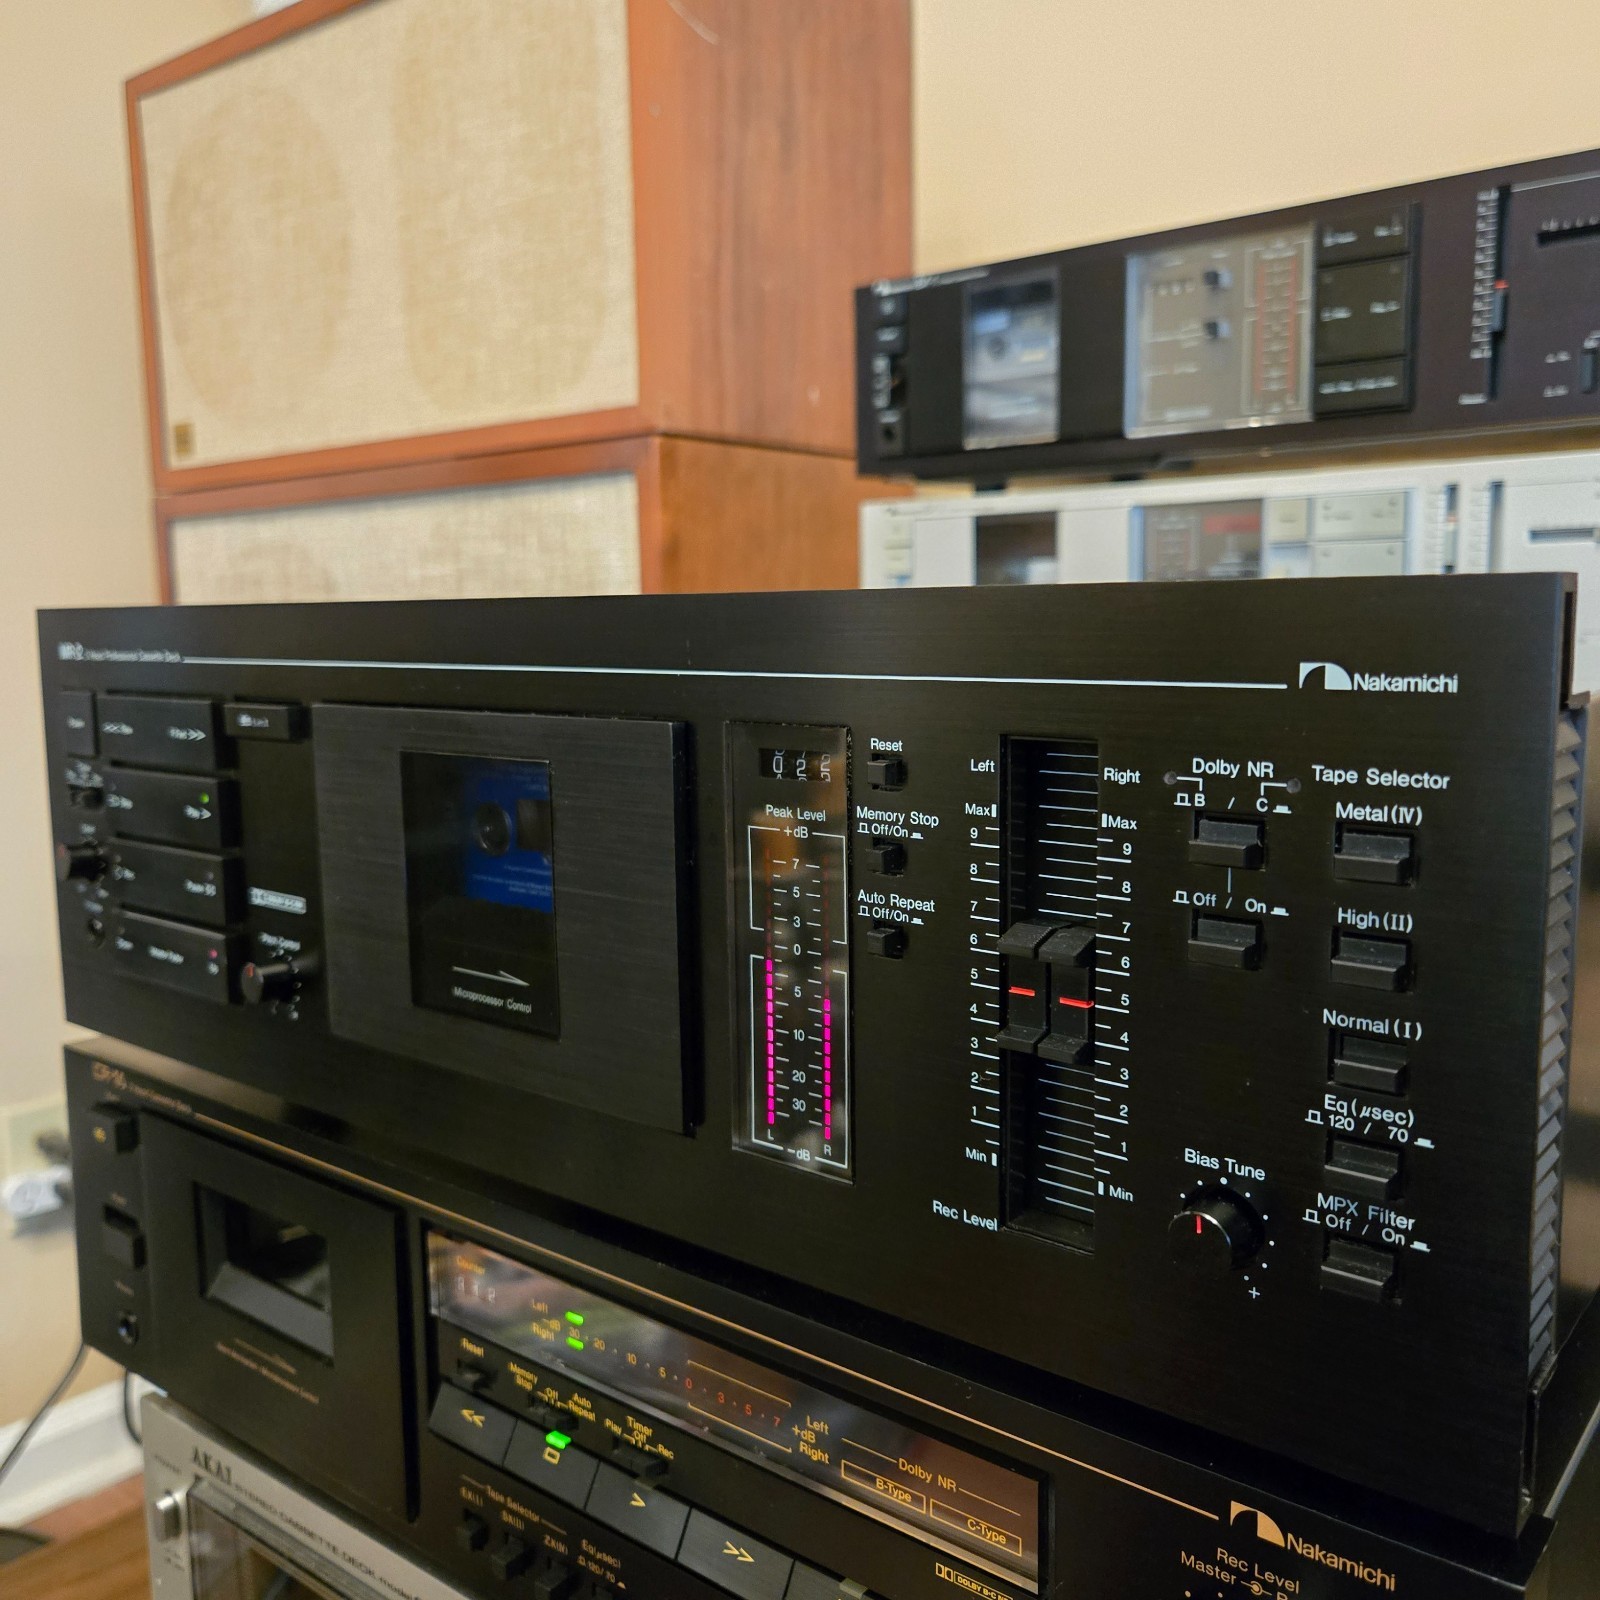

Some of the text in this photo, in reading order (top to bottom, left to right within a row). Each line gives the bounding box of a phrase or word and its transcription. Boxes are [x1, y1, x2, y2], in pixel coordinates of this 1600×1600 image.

[1353, 672, 1459, 694] Nakamichi
[870, 737, 903, 752] Reset
[970, 758, 996, 773] Left
[1192, 757, 1275, 778] Dolby NR
[1103, 767, 1141, 785] Right
[1311, 764, 1451, 790] Tape Selector
[765, 804, 826, 822] Peak Level
[856, 805, 940, 829] Memory Stop
[965, 802, 990, 817] Max
[871, 823, 909, 839] Off/On
[1108, 814, 1138, 831] Max
[783, 826, 809, 839] +dB
[970, 827, 979, 839] 9
[1122, 842, 1132, 856] 9
[792, 858, 800, 870] 7
[969, 863, 978, 875] 8
[792, 886, 800, 898] 5
[1122, 881, 1132, 894] 8
[857, 888, 936, 913] Auto Repeat
[970, 900, 978, 912] 7
[1192, 892, 1217, 907] Off
[1244, 898, 1266, 914] On
[793, 916, 801, 928] 3
[872, 907, 910, 924] Off/On
[1122, 921, 1131, 934] 7
[970, 933, 978, 945] 6
[793, 943, 802, 956] 0
[1121, 956, 1131, 969] 6
[970, 967, 979, 980] 5
[794, 986, 802, 998] 5
[1120, 994, 1130, 1006] 5
[507, 998, 532, 1014] Control
[969, 1003, 978, 1014] 4
[793, 1029, 806, 1042] 10
[970, 1037, 979, 1049] 3
[1120, 1031, 1130, 1044] 4
[792, 1070, 806, 1083] 20
[971, 1072, 979, 1084] 2
[1120, 1068, 1129, 1081] 3
[792, 1099, 806, 1112] 30
[971, 1105, 978, 1117] 1
[1119, 1104, 1129, 1117] 2
[767, 1128, 775, 1141] L
[1328, 1113, 1355, 1133] 120
[1388, 1126, 1410, 1143] 70
[823, 1144, 832, 1156] R
[965, 1146, 987, 1163] Min
[1120, 1140, 1128, 1153] 1
[1183, 1147, 1267, 1182] Bias Tune
[1109, 1184, 1134, 1202] Min
[932, 1199, 999, 1232] Rec Level
[1317, 1192, 1416, 1232] MPX Filter
[1324, 1213, 1352, 1233] Off
[1381, 1227, 1407, 1246] On
[532, 1298, 549, 1314] Left
[532, 1321, 555, 1342] Right
[508, 1361, 539, 1385] Memory
[569, 1326, 781, 1428] 30 20 10 5 0 3 5 7
[572, 1392, 592, 1410] Auto
[568, 1401, 597, 1422] Repeat
[604, 1417, 622, 1436] Play
[626, 1415, 654, 1437] Timer
[792, 1424, 816, 1443] +dB
[807, 1415, 829, 1435] Left
[658, 1443, 675, 1460] Rec
[799, 1441, 830, 1464] Right
[193, 1447, 232, 1485] AKAI
[898, 1458, 957, 1493] Dolby NR
[876, 1477, 912, 1503] B-Type
[967, 1518, 1007, 1544] C-Type
[1180, 1550, 1238, 1586] Master
[1216, 1546, 1300, 1595] Rec Level
[1287, 1531, 1397, 1593] Nakamichi
[957, 1575, 982, 1593] DOLBY
